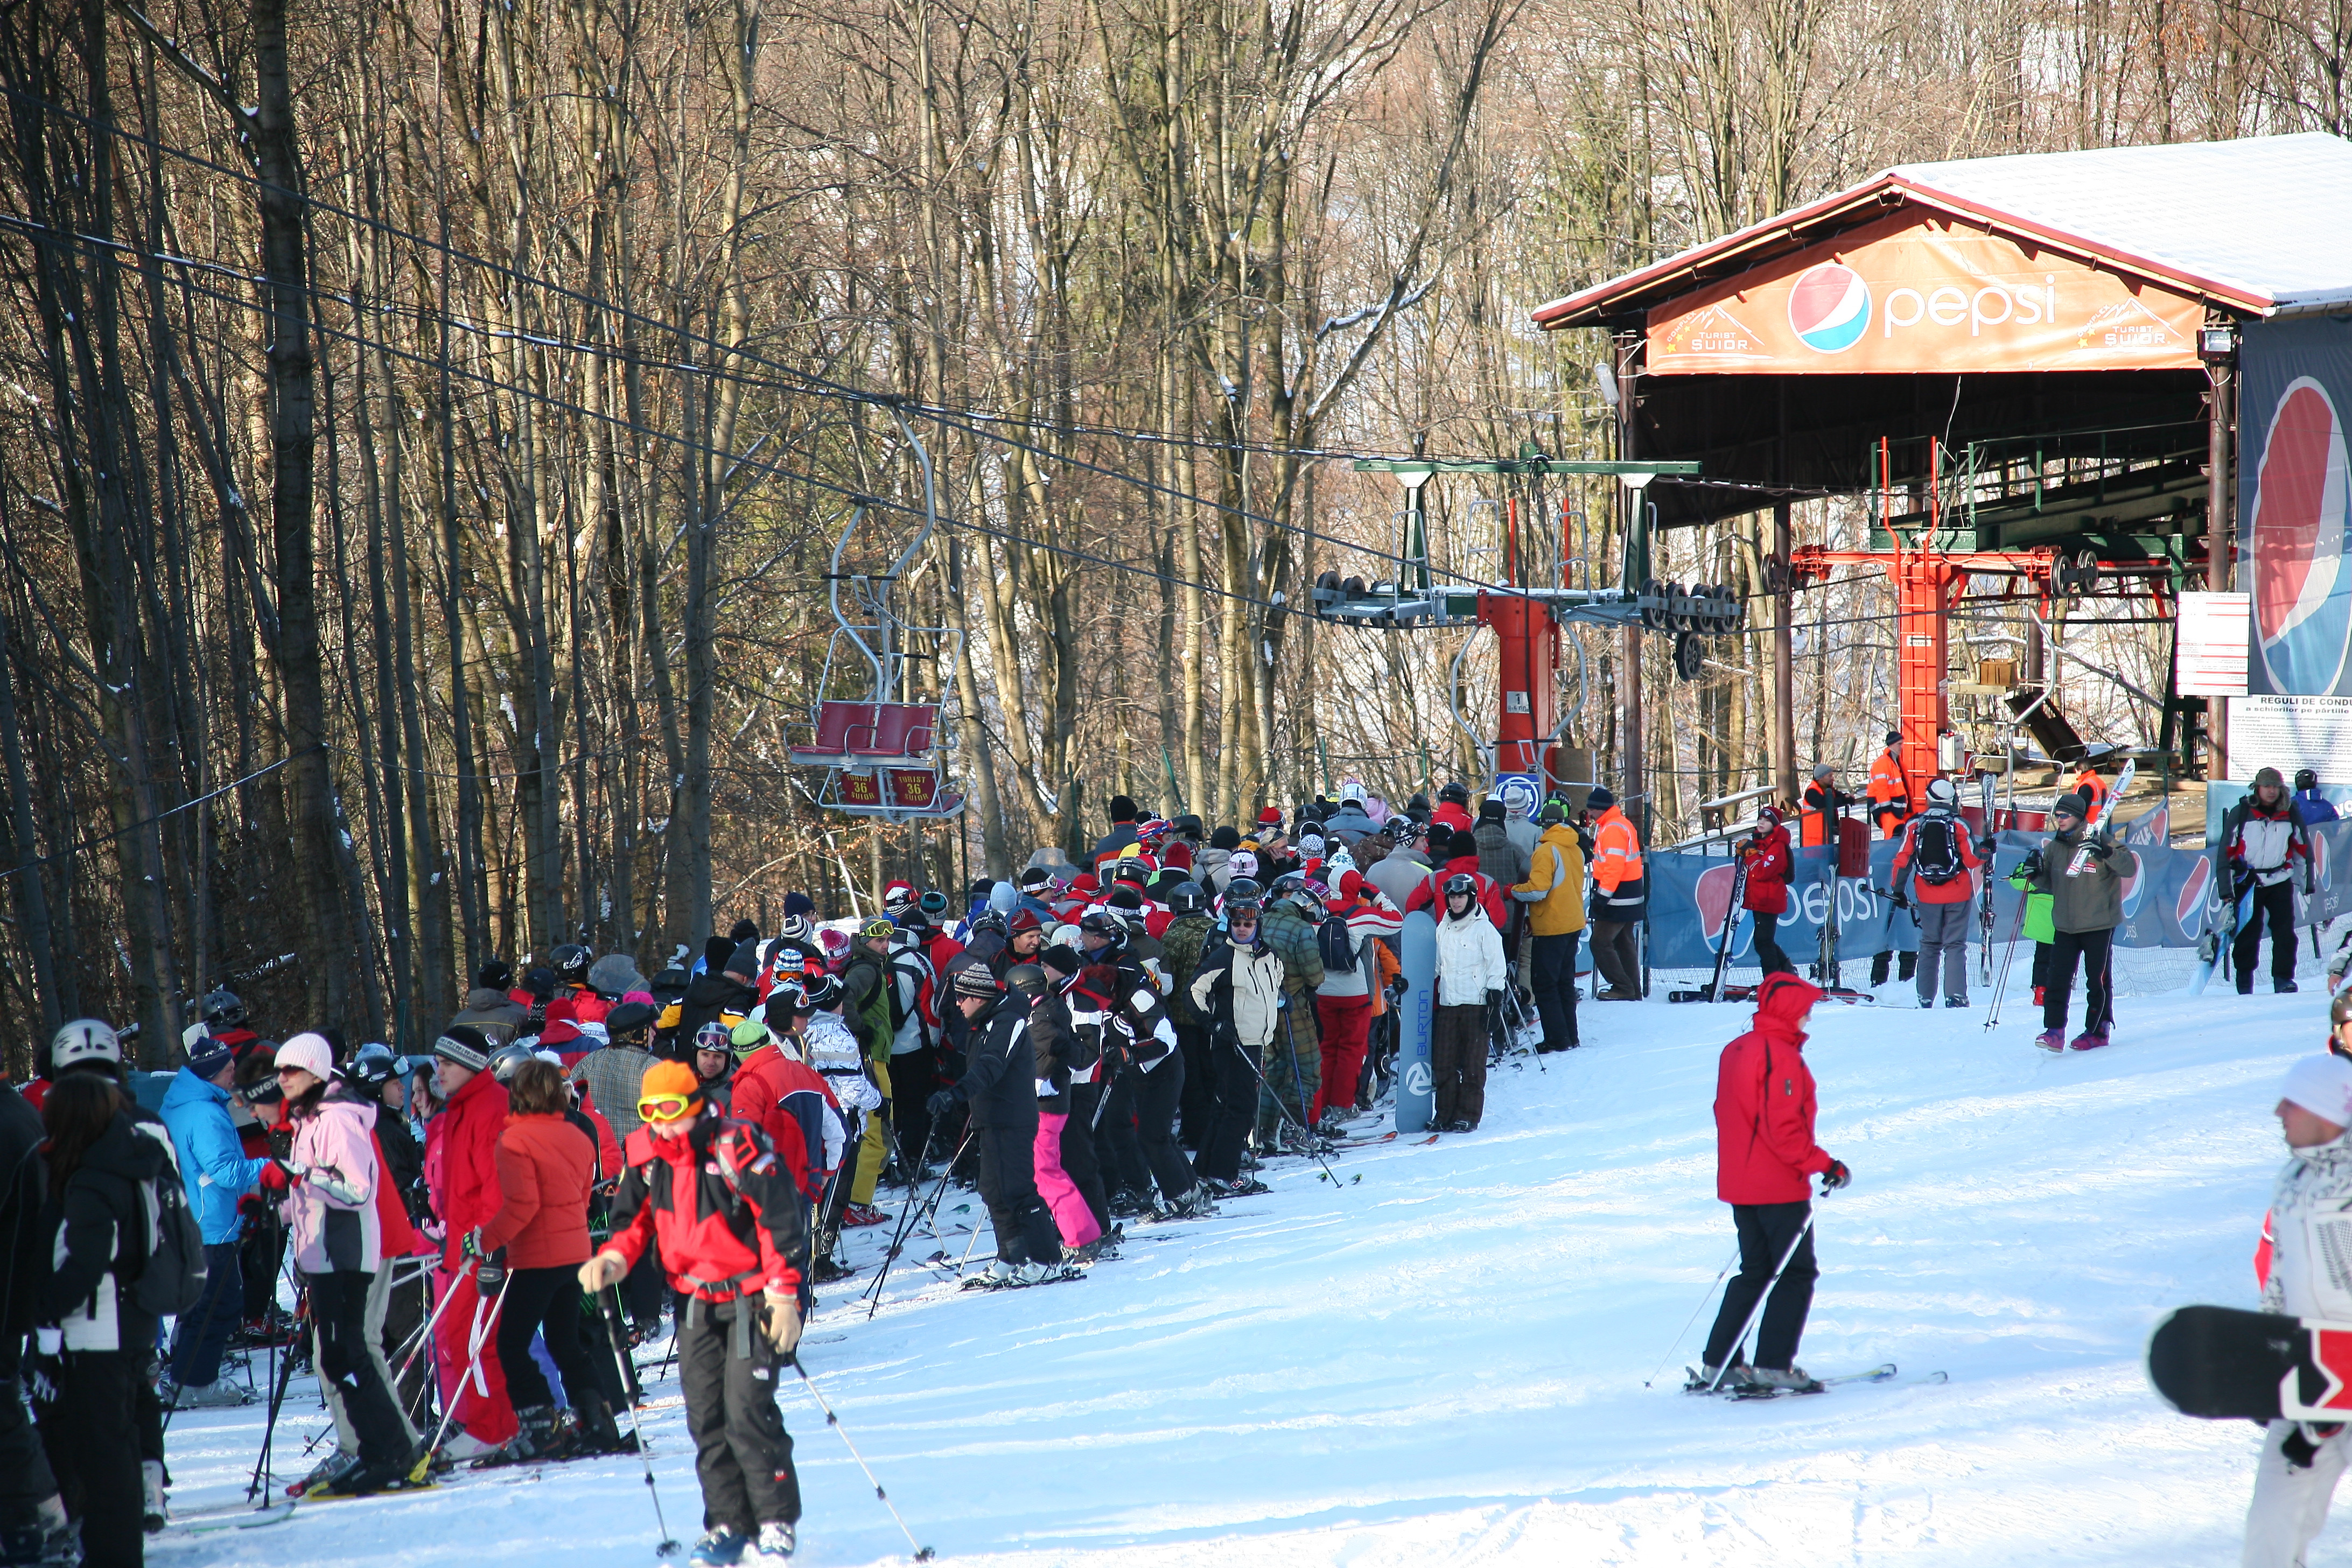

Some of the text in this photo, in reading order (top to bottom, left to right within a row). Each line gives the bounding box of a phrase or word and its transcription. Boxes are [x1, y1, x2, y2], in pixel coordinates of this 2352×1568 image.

[1885, 274, 2055, 338] pepsi
[1667, 311, 1697, 342] COMPLEX
[853, 782, 867, 793] 36
[907, 783, 921, 794] 36
[851, 792, 875, 800] SUIOR
[905, 793, 928, 801] SUIOR
[1417, 990, 1433, 1056] BURTON
[247, 1078, 278, 1099] uvex
